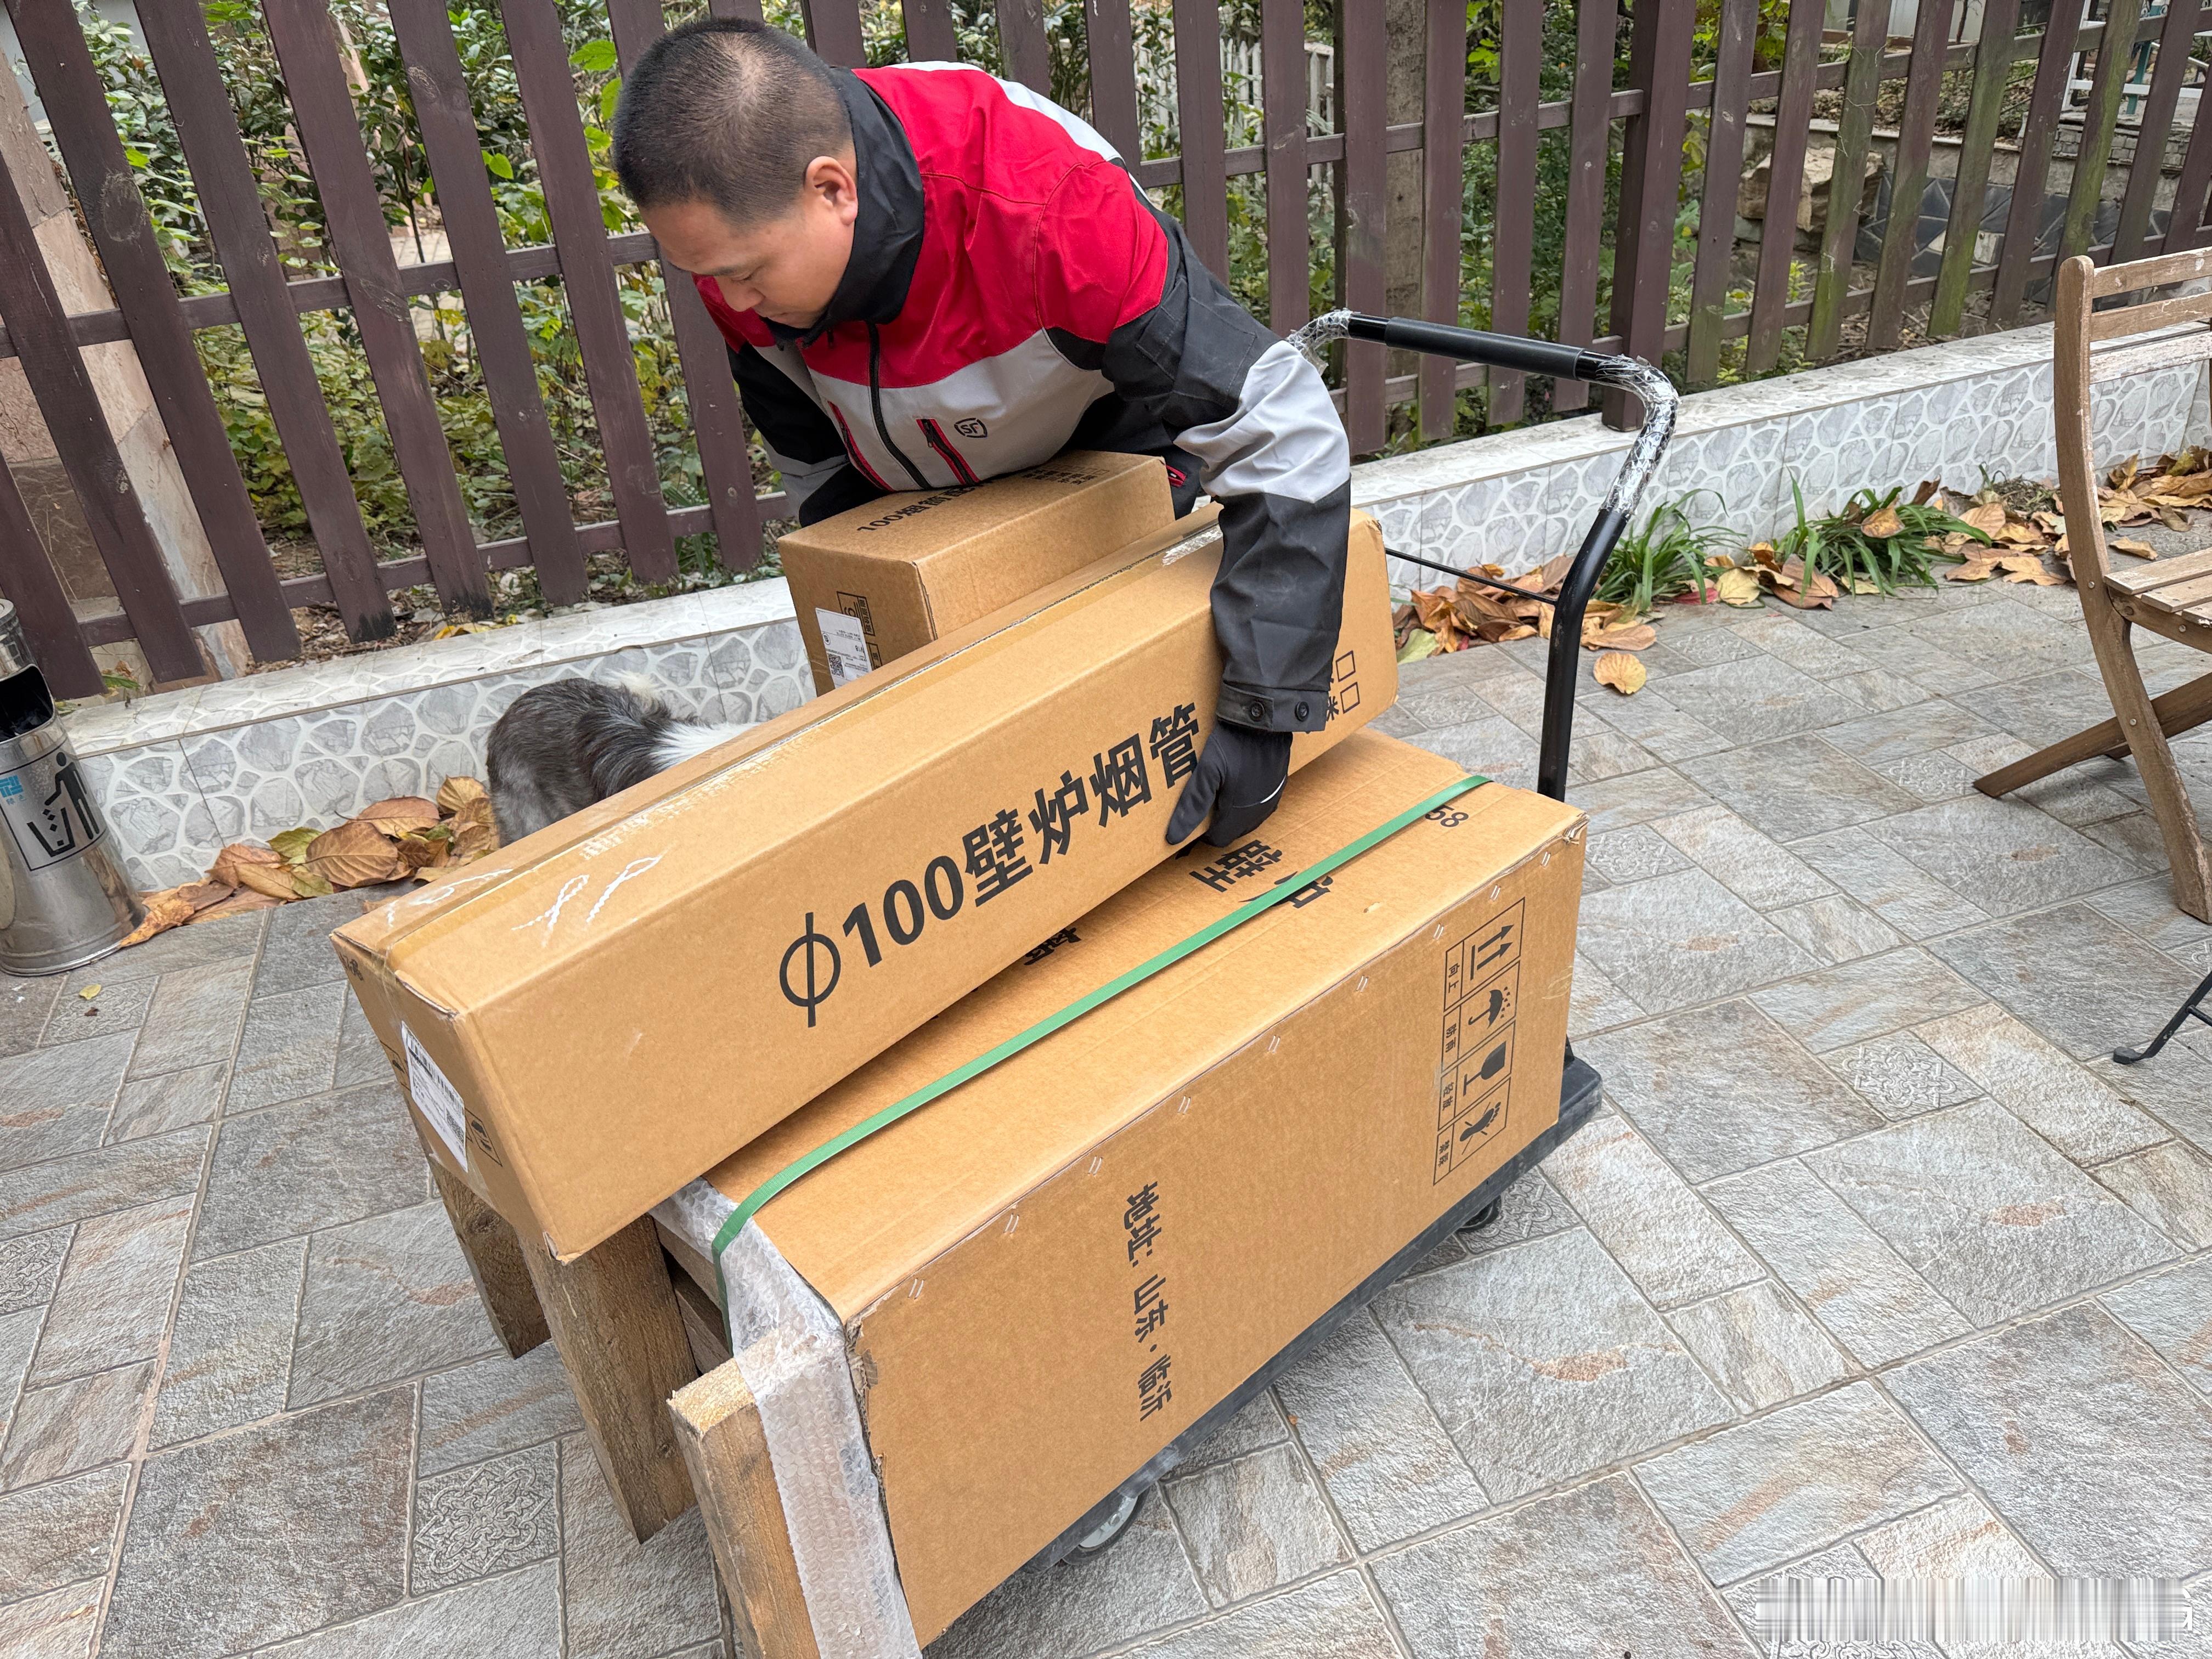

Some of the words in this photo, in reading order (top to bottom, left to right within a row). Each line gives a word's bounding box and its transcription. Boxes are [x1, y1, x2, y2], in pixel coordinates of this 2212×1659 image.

[961, 422, 979, 434] SF
[1448, 963, 1460, 994] 向上
[1446, 1023, 1457, 1053] 防雨
[1442, 1082, 1454, 1111] 轻放
